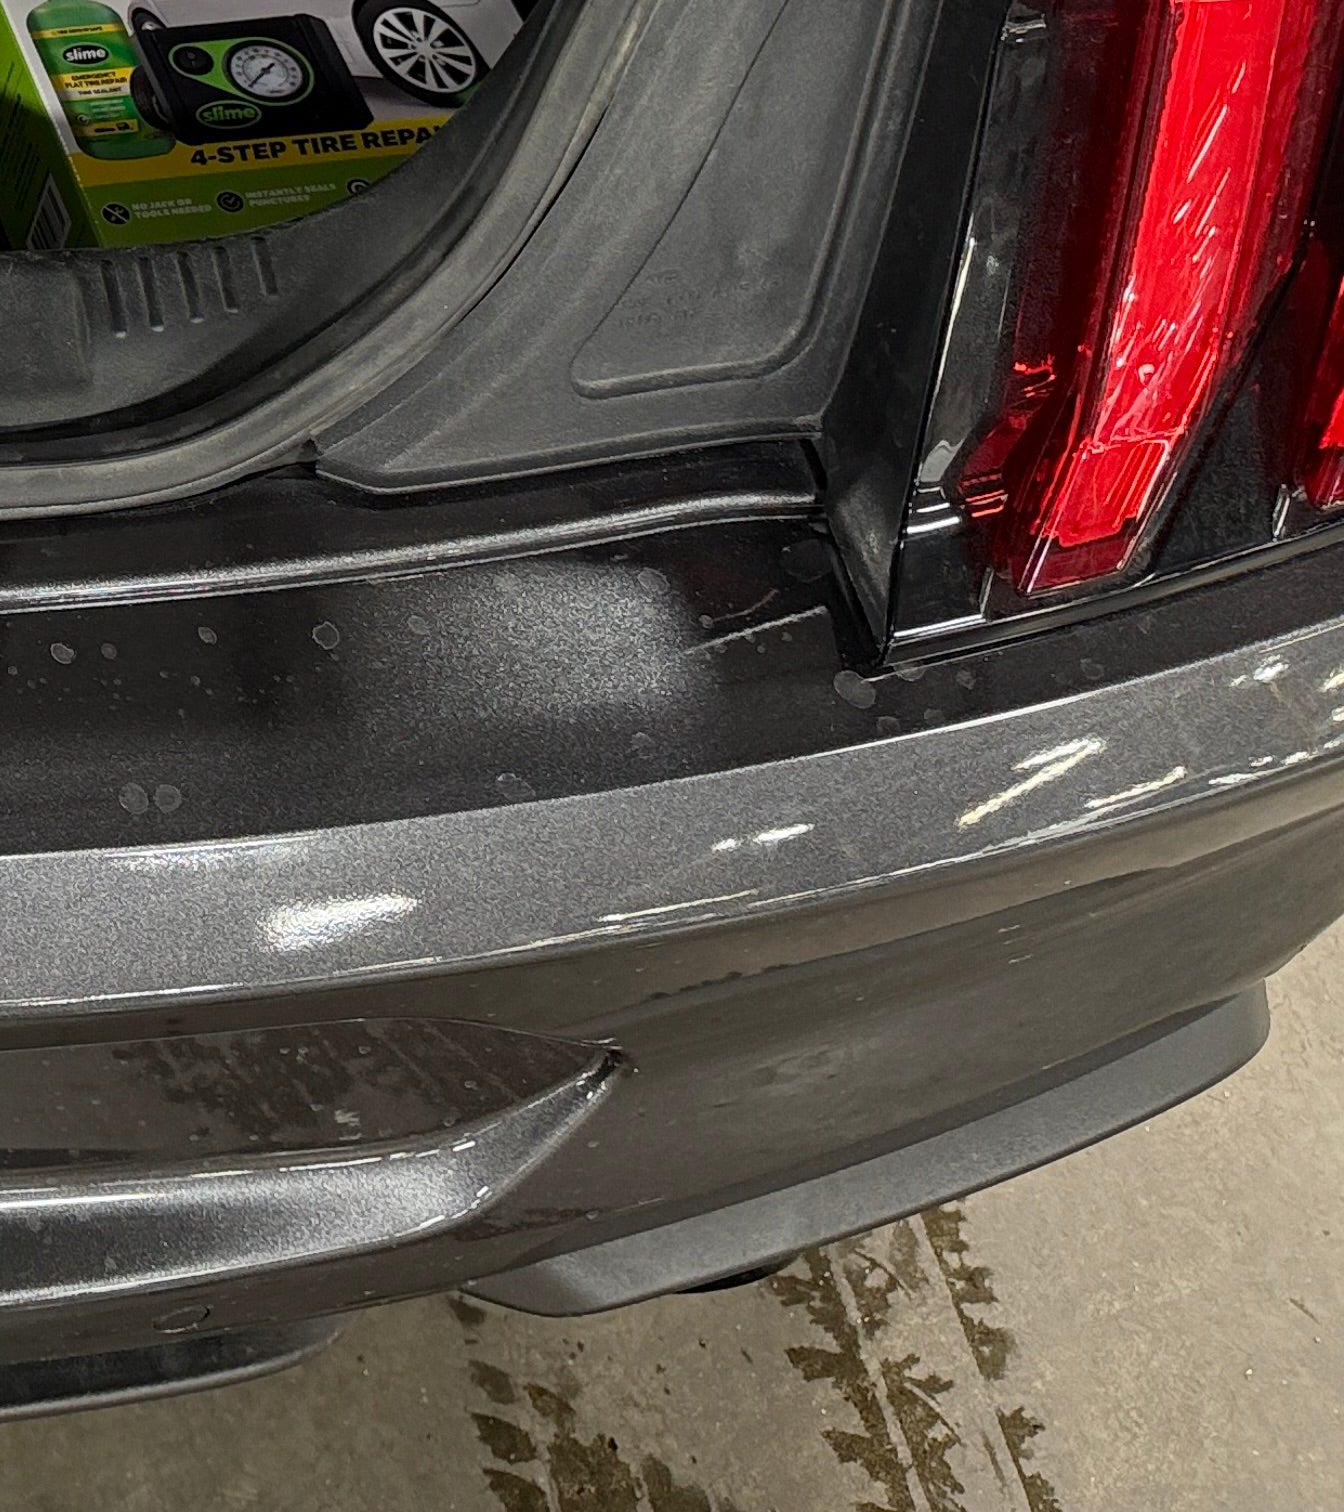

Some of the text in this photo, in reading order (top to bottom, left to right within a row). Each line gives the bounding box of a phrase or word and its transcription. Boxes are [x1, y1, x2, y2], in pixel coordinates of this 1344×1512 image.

[64, 47, 108, 63] slime
[201, 101, 257, 123] slime
[190, 125, 440, 166] 4-STEP TIRE REPA
